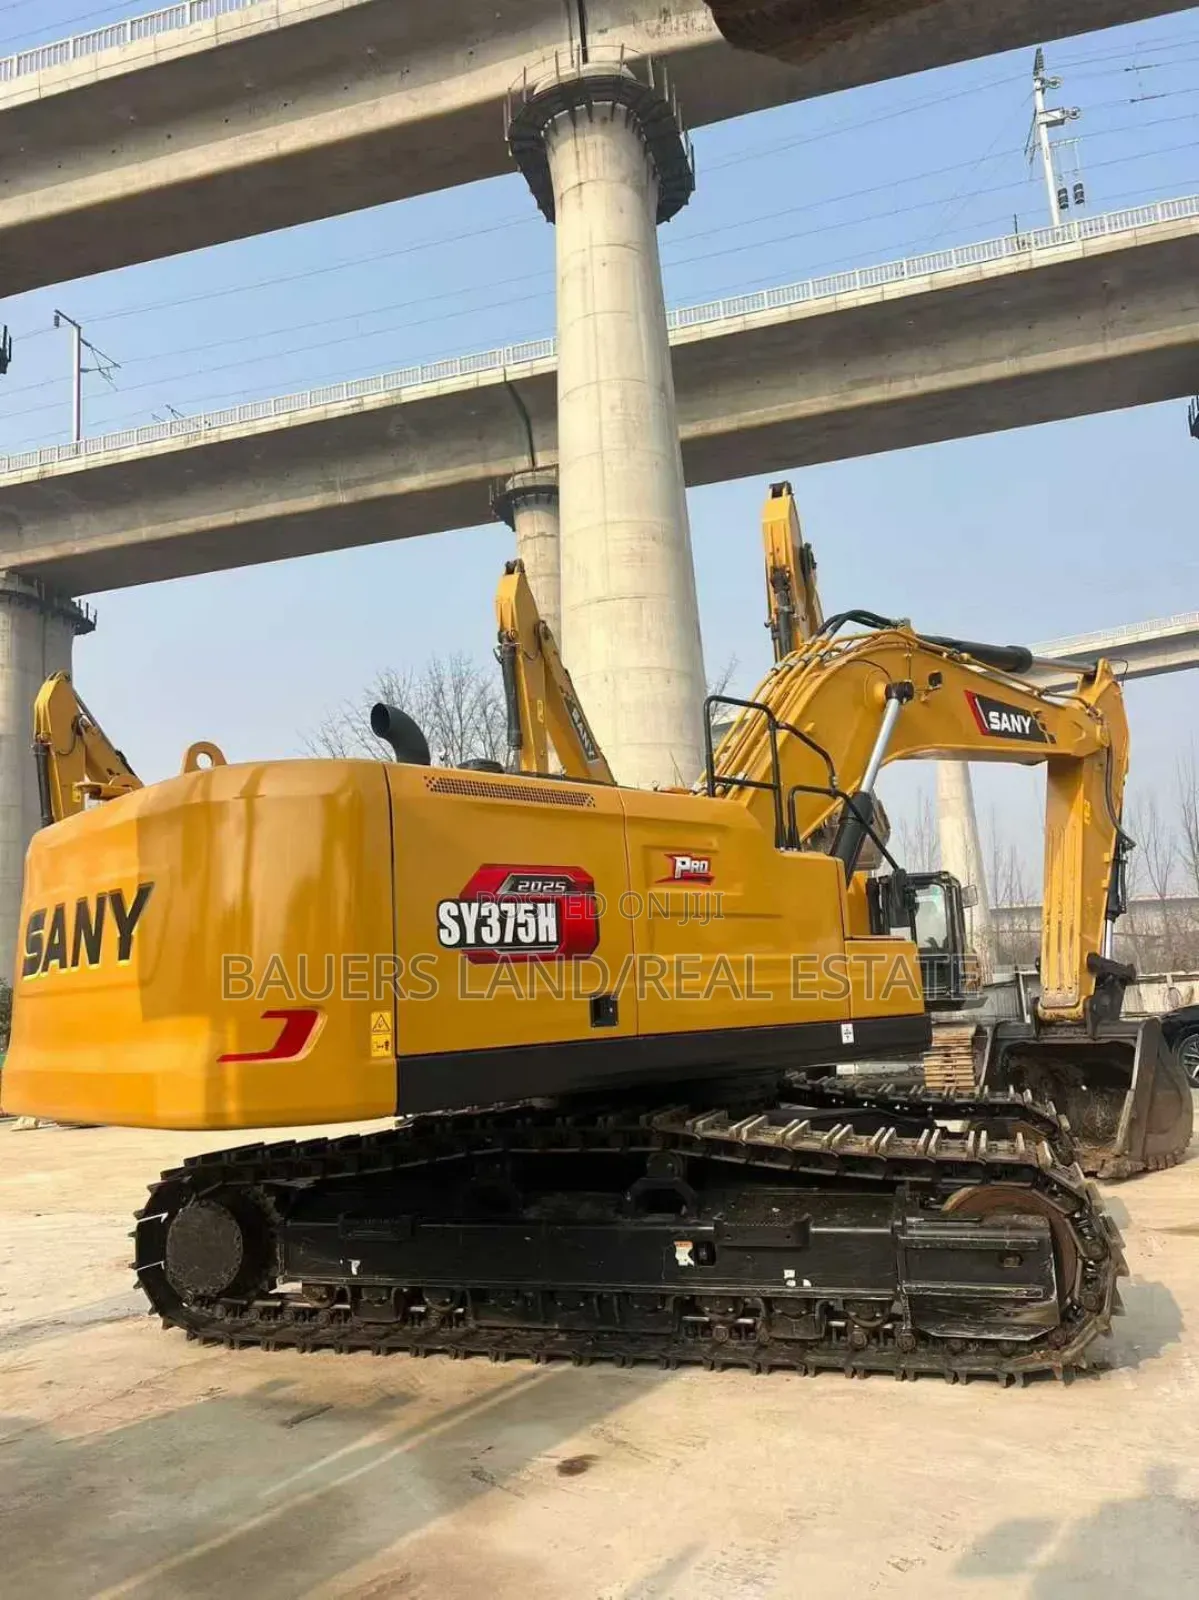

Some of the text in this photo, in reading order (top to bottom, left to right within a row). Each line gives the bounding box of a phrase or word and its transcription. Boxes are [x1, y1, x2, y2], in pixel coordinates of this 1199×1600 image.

[988, 711, 1031, 734] SANY
[517, 880, 566, 893] 2025
[22, 881, 154, 980] SANY
[438, 901, 557, 945] SY375H
